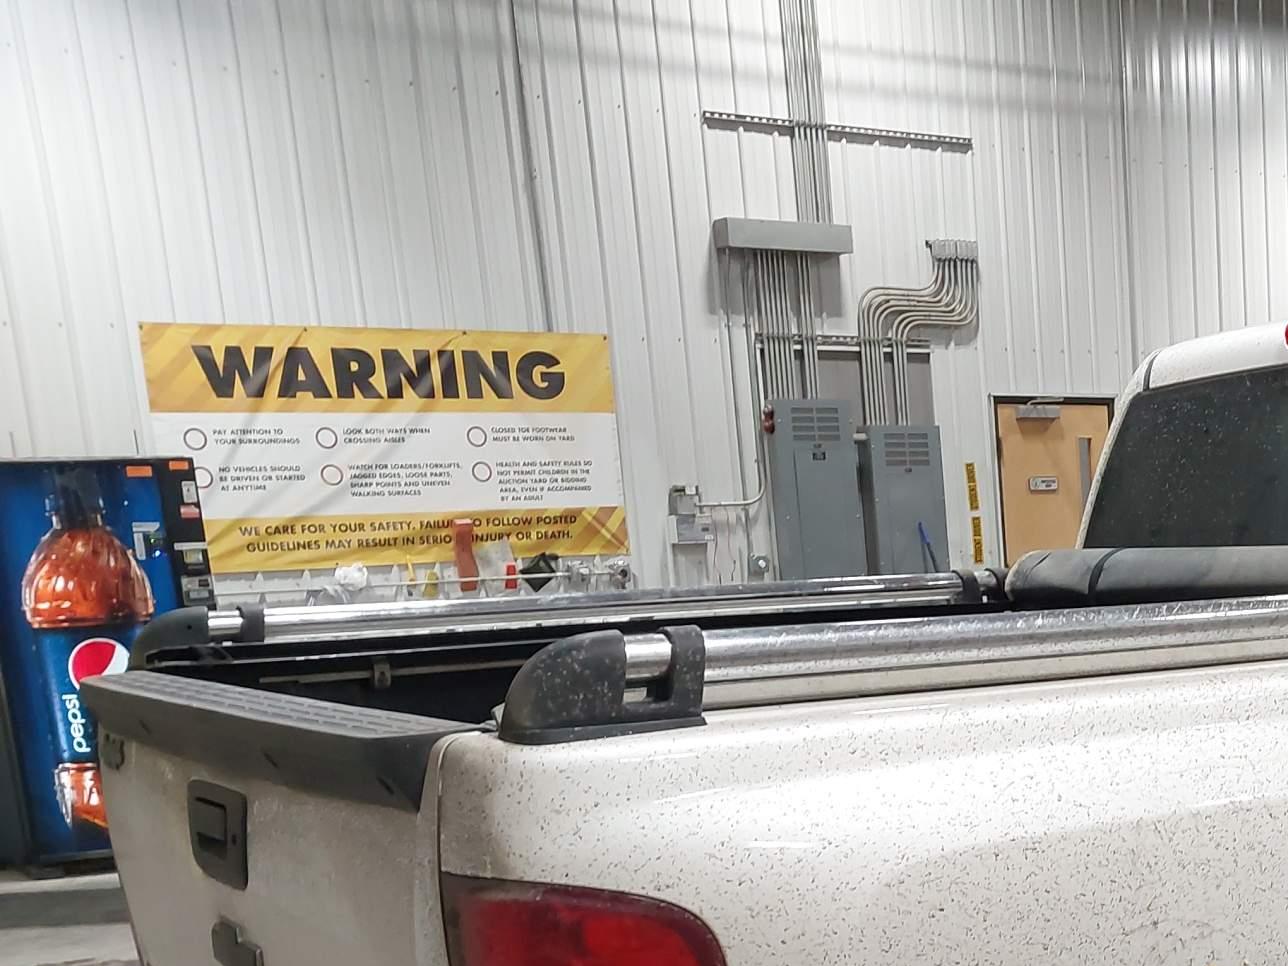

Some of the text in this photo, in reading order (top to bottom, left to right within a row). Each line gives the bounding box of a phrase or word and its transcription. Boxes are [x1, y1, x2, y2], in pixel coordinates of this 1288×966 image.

[192, 345, 565, 400] WARNING
[239, 526, 260, 537] WE
[264, 525, 296, 536] CARE
[301, 523, 326, 534] FOR
[330, 522, 366, 533] YOUR
[370, 520, 416, 532] SAFETY.
[419, 519, 456, 530] FAILU
[486, 516, 532, 527] FOLLOW
[536, 514, 577, 525] POSTED
[246, 539, 320, 553] GUIDELINES
[325, 538, 352, 549] MAY
[357, 536, 398, 548] RESULT
[402, 536, 415, 546] IN
[419, 535, 453, 545] SERIO
[515, 530, 532, 541] OR
[536, 529, 573, 540] DEATH.
[62, 694, 91, 753] pepsi
